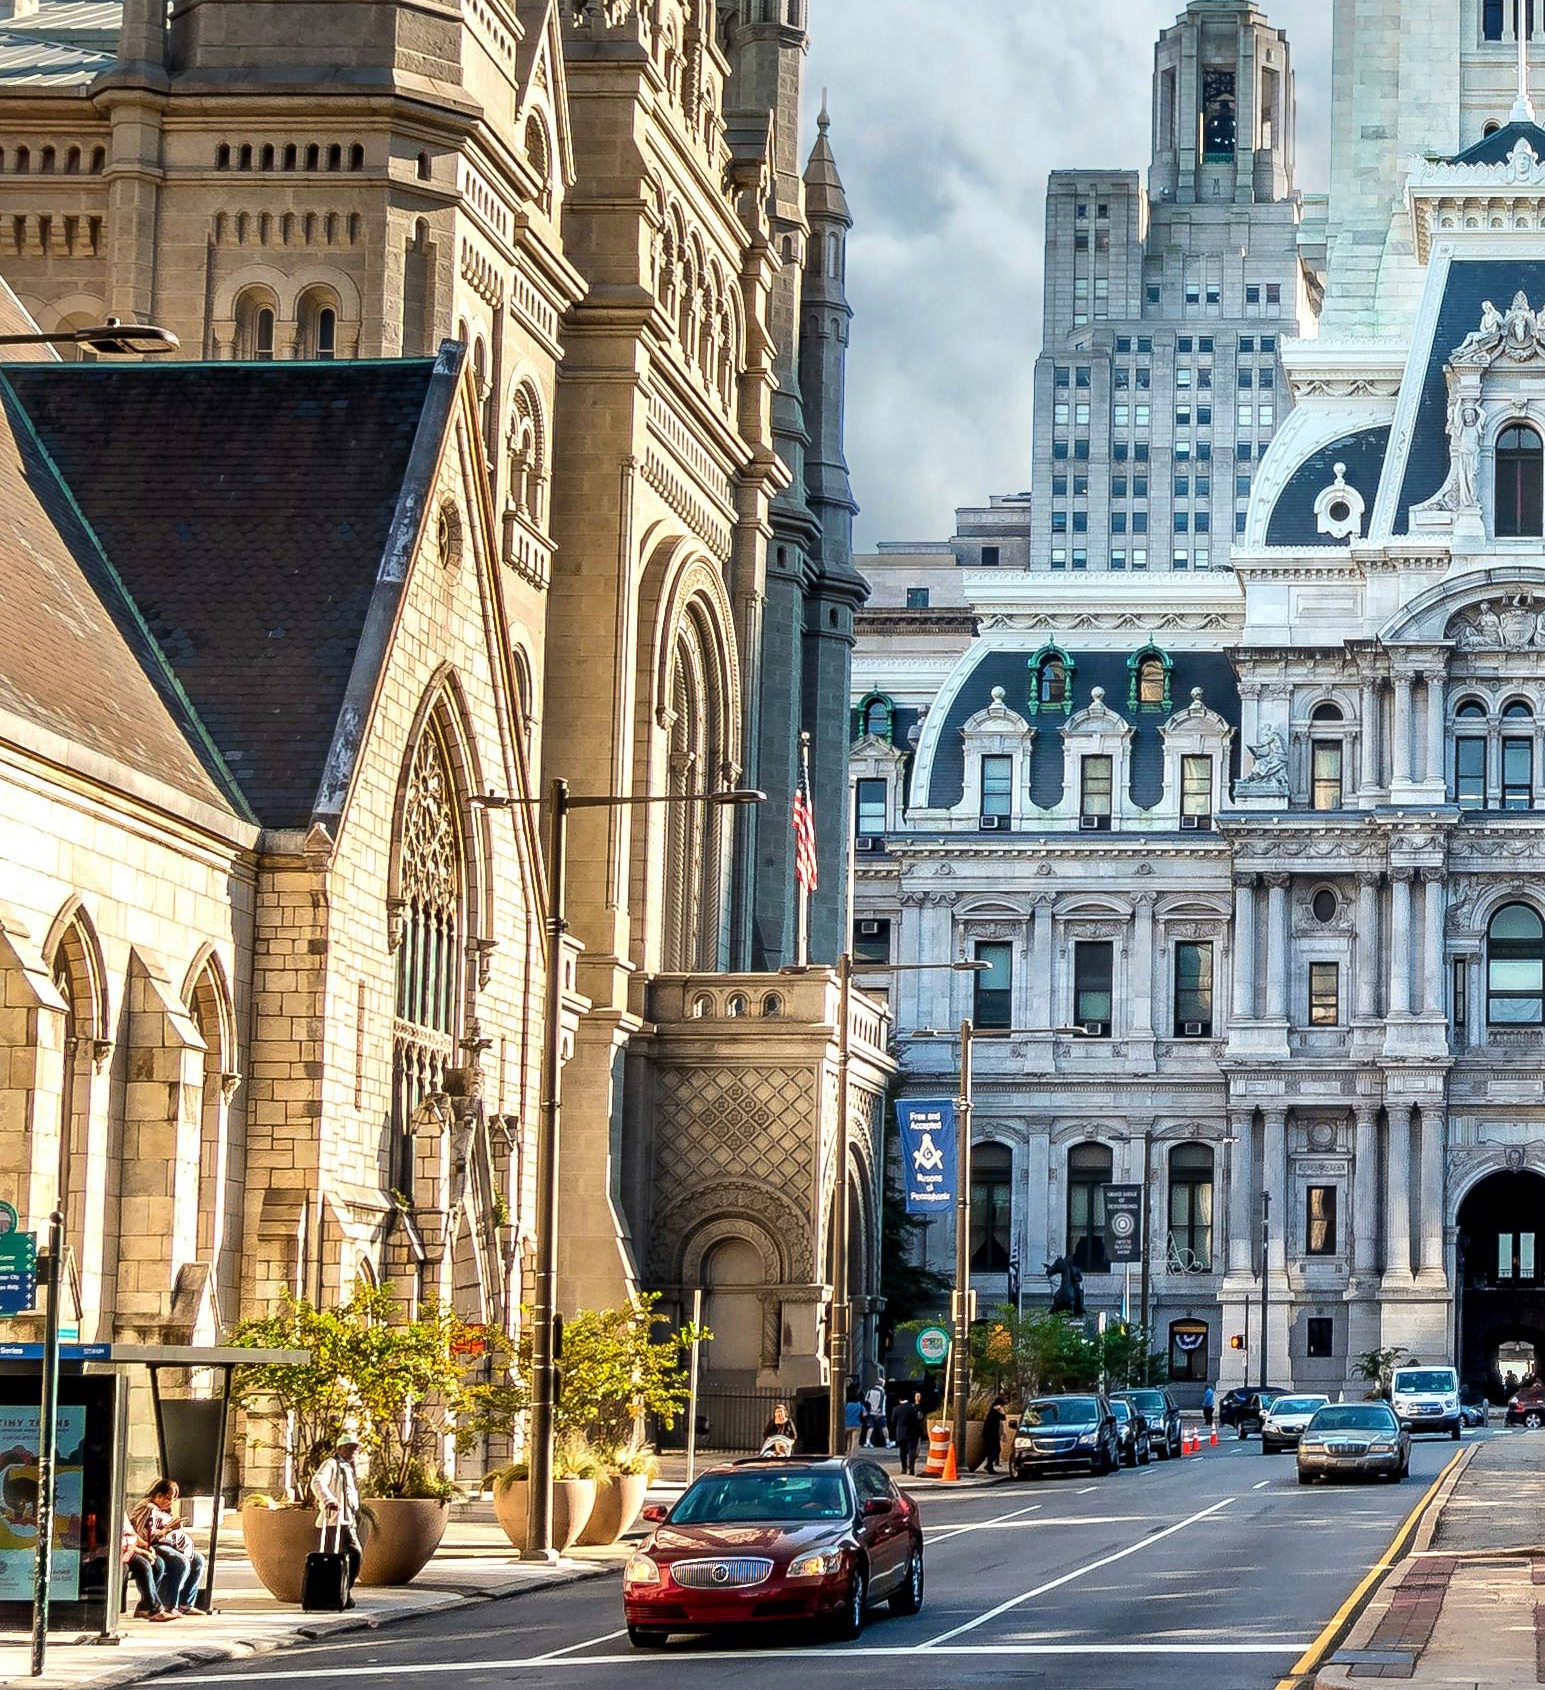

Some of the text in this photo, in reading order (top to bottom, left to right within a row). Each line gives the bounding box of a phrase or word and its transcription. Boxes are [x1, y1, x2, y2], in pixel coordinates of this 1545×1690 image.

[909, 1112, 941, 1121] Free and
[910, 1121, 942, 1131] Accepted
[916, 1173, 943, 1183] Masons
[925, 1183, 934, 1192] of
[910, 1192, 951, 1203] Pennsylvania
[0, 1347, 23, 1355] Series
